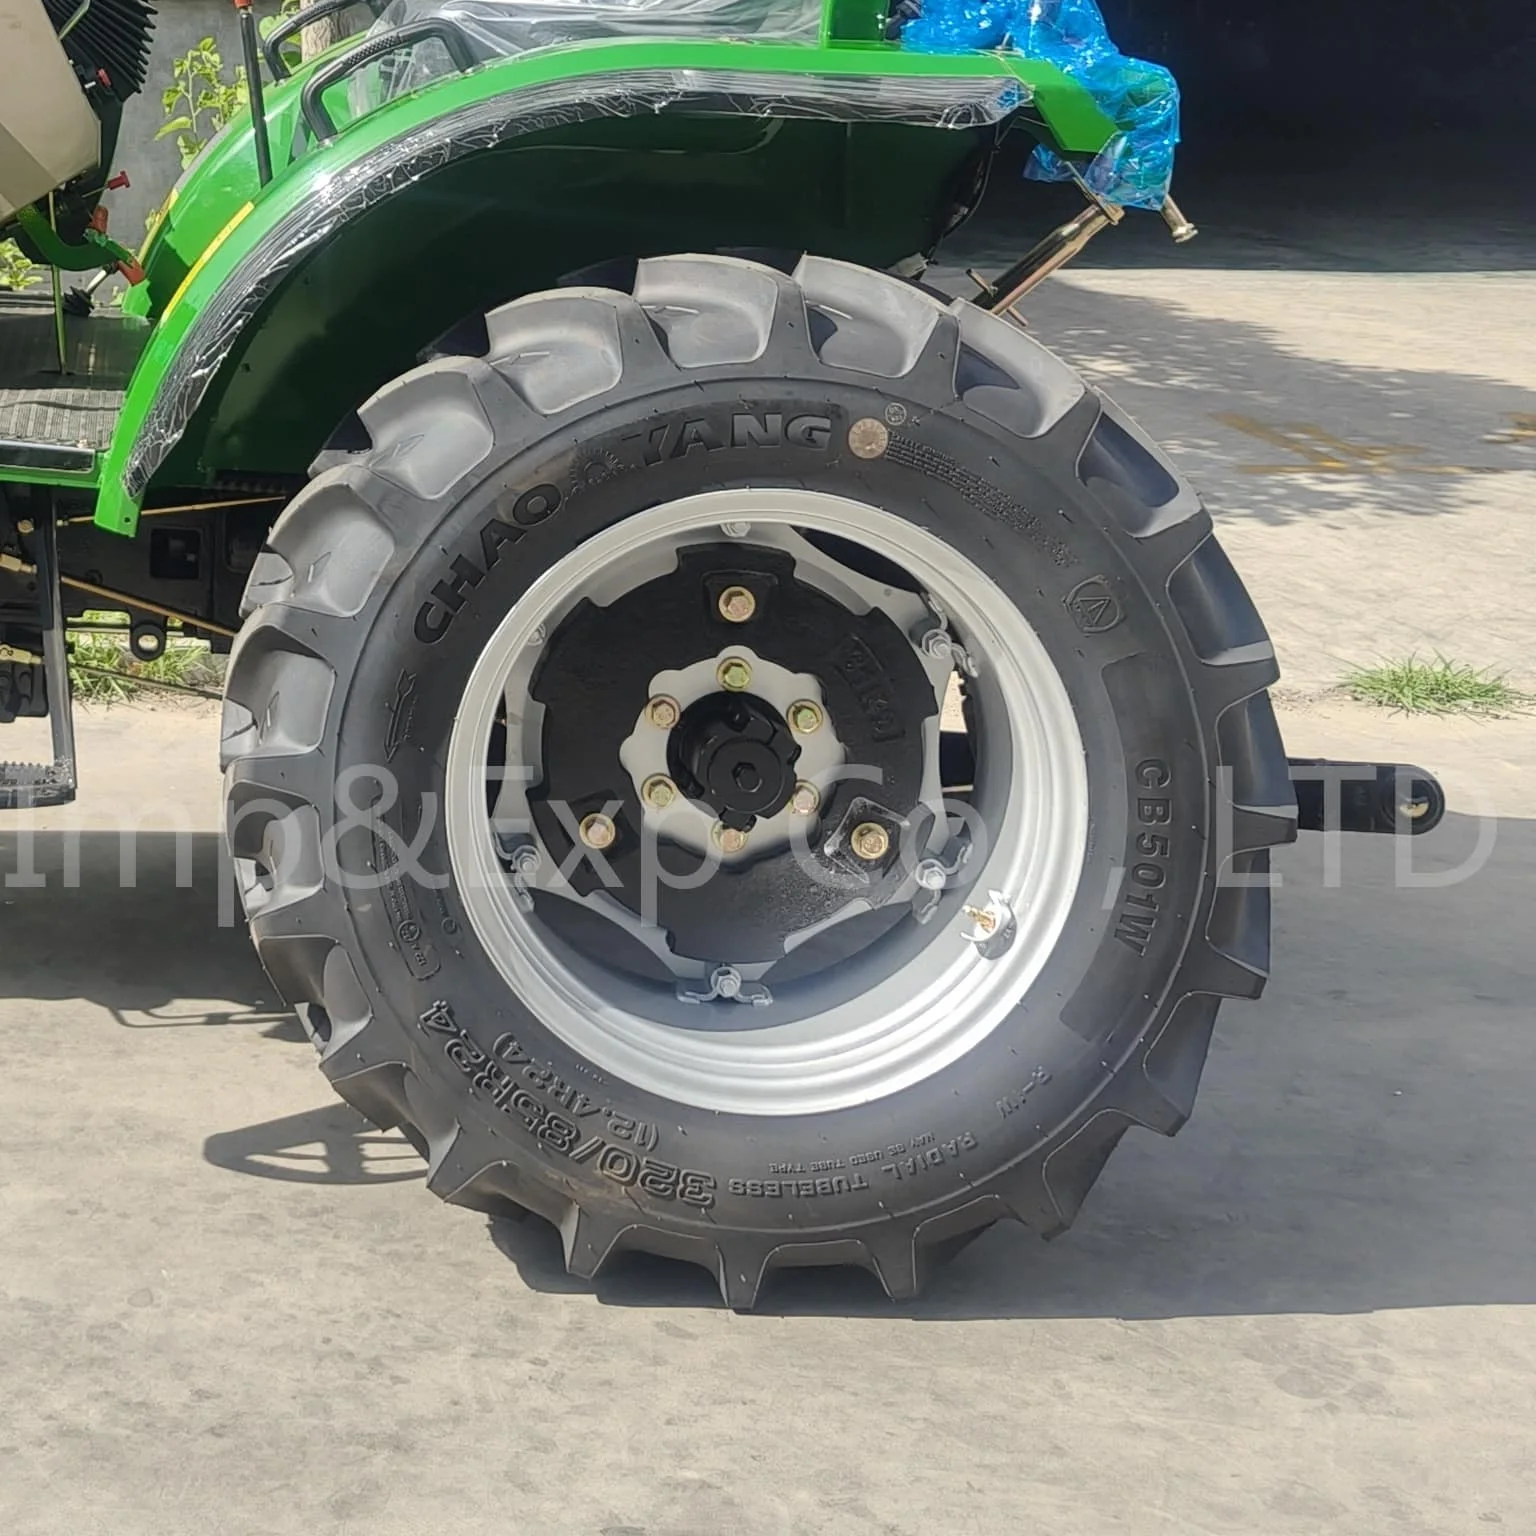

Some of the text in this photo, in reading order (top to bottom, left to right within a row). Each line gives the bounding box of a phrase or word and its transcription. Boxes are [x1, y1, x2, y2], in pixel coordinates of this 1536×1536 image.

[414, 411, 833, 644] CHAO YANG
[1113, 758, 1172, 957] CB501W
[417, 999, 718, 1211] 320/85R24
[492, 1030, 659, 1152] (12.4R24)
[728, 1131, 978, 1199] RADIAL TUBELESS
